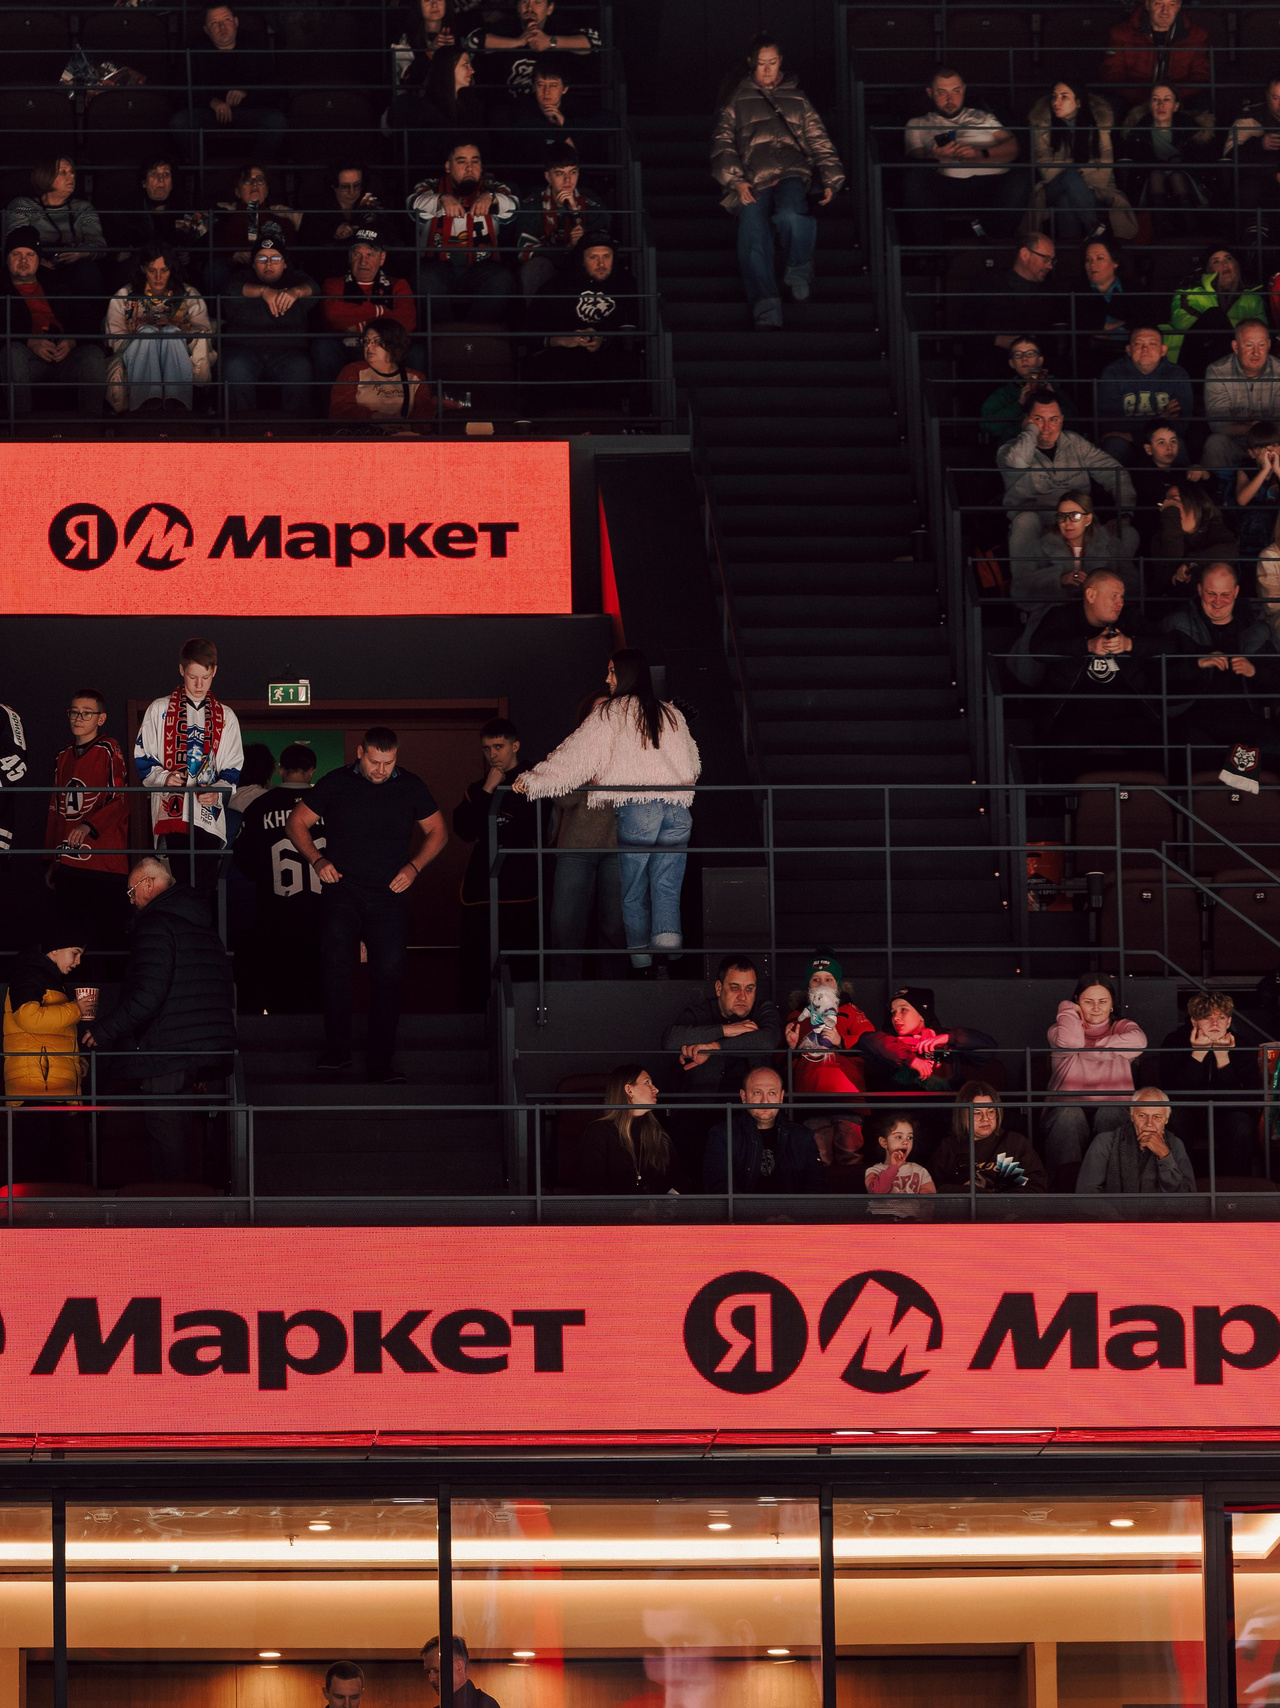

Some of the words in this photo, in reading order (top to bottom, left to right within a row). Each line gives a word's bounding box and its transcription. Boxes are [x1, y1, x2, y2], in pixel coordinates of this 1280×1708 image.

[1123, 390, 1170, 417] GAP
[208, 515, 518, 568] Маркет
[0, 754, 28, 782] 45
[29, 1296, 586, 1391] Маркет
